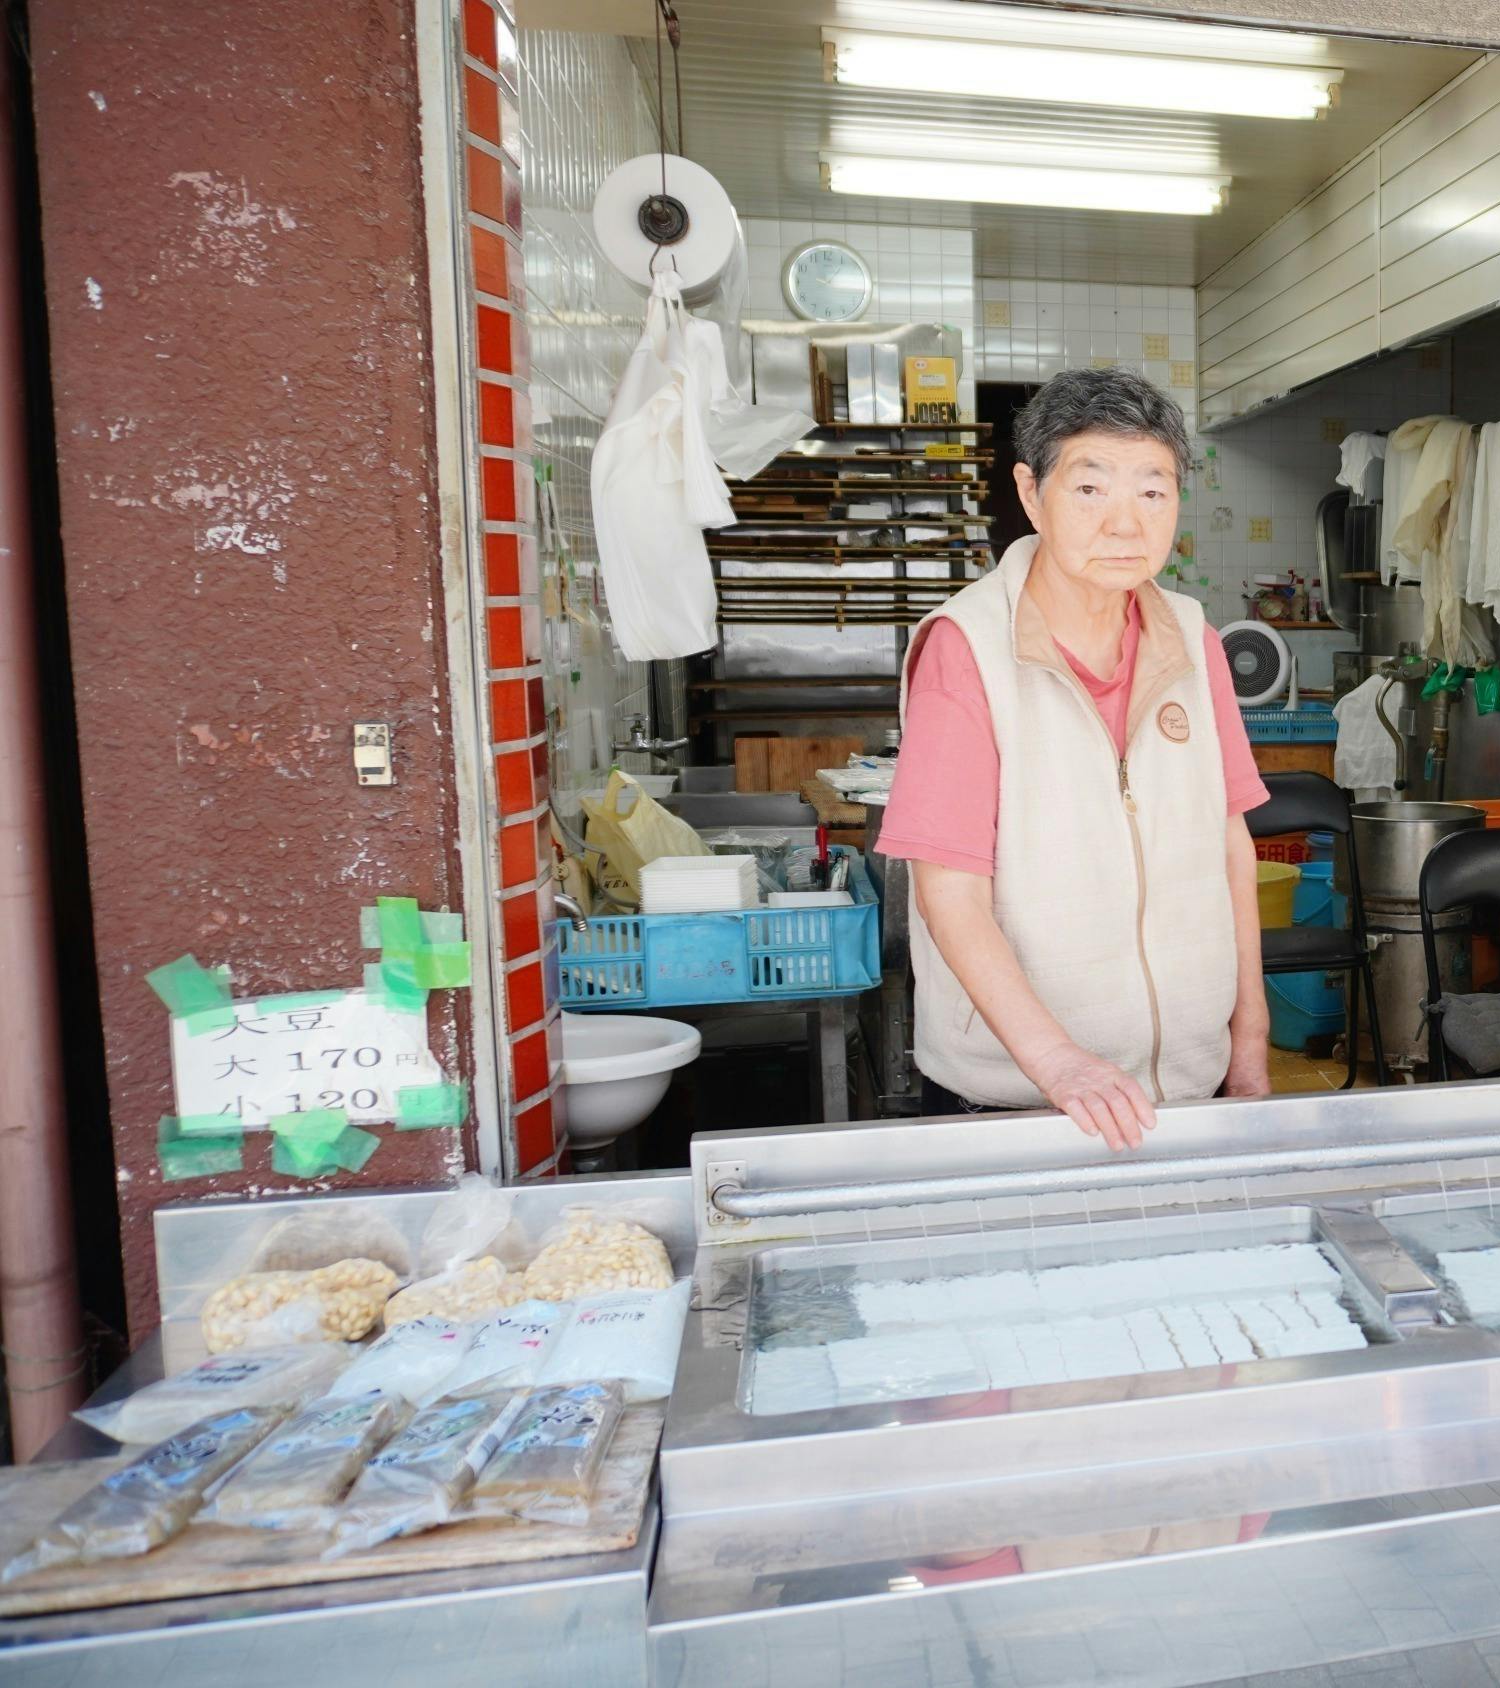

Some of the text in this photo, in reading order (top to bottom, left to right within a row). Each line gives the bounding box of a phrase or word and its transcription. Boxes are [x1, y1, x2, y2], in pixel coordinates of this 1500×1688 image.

[910, 402, 957, 423] JOGEN
[211, 1007, 335, 1042] 大豆
[213, 1055, 257, 1080] 大
[217, 1095, 262, 1119] 小
